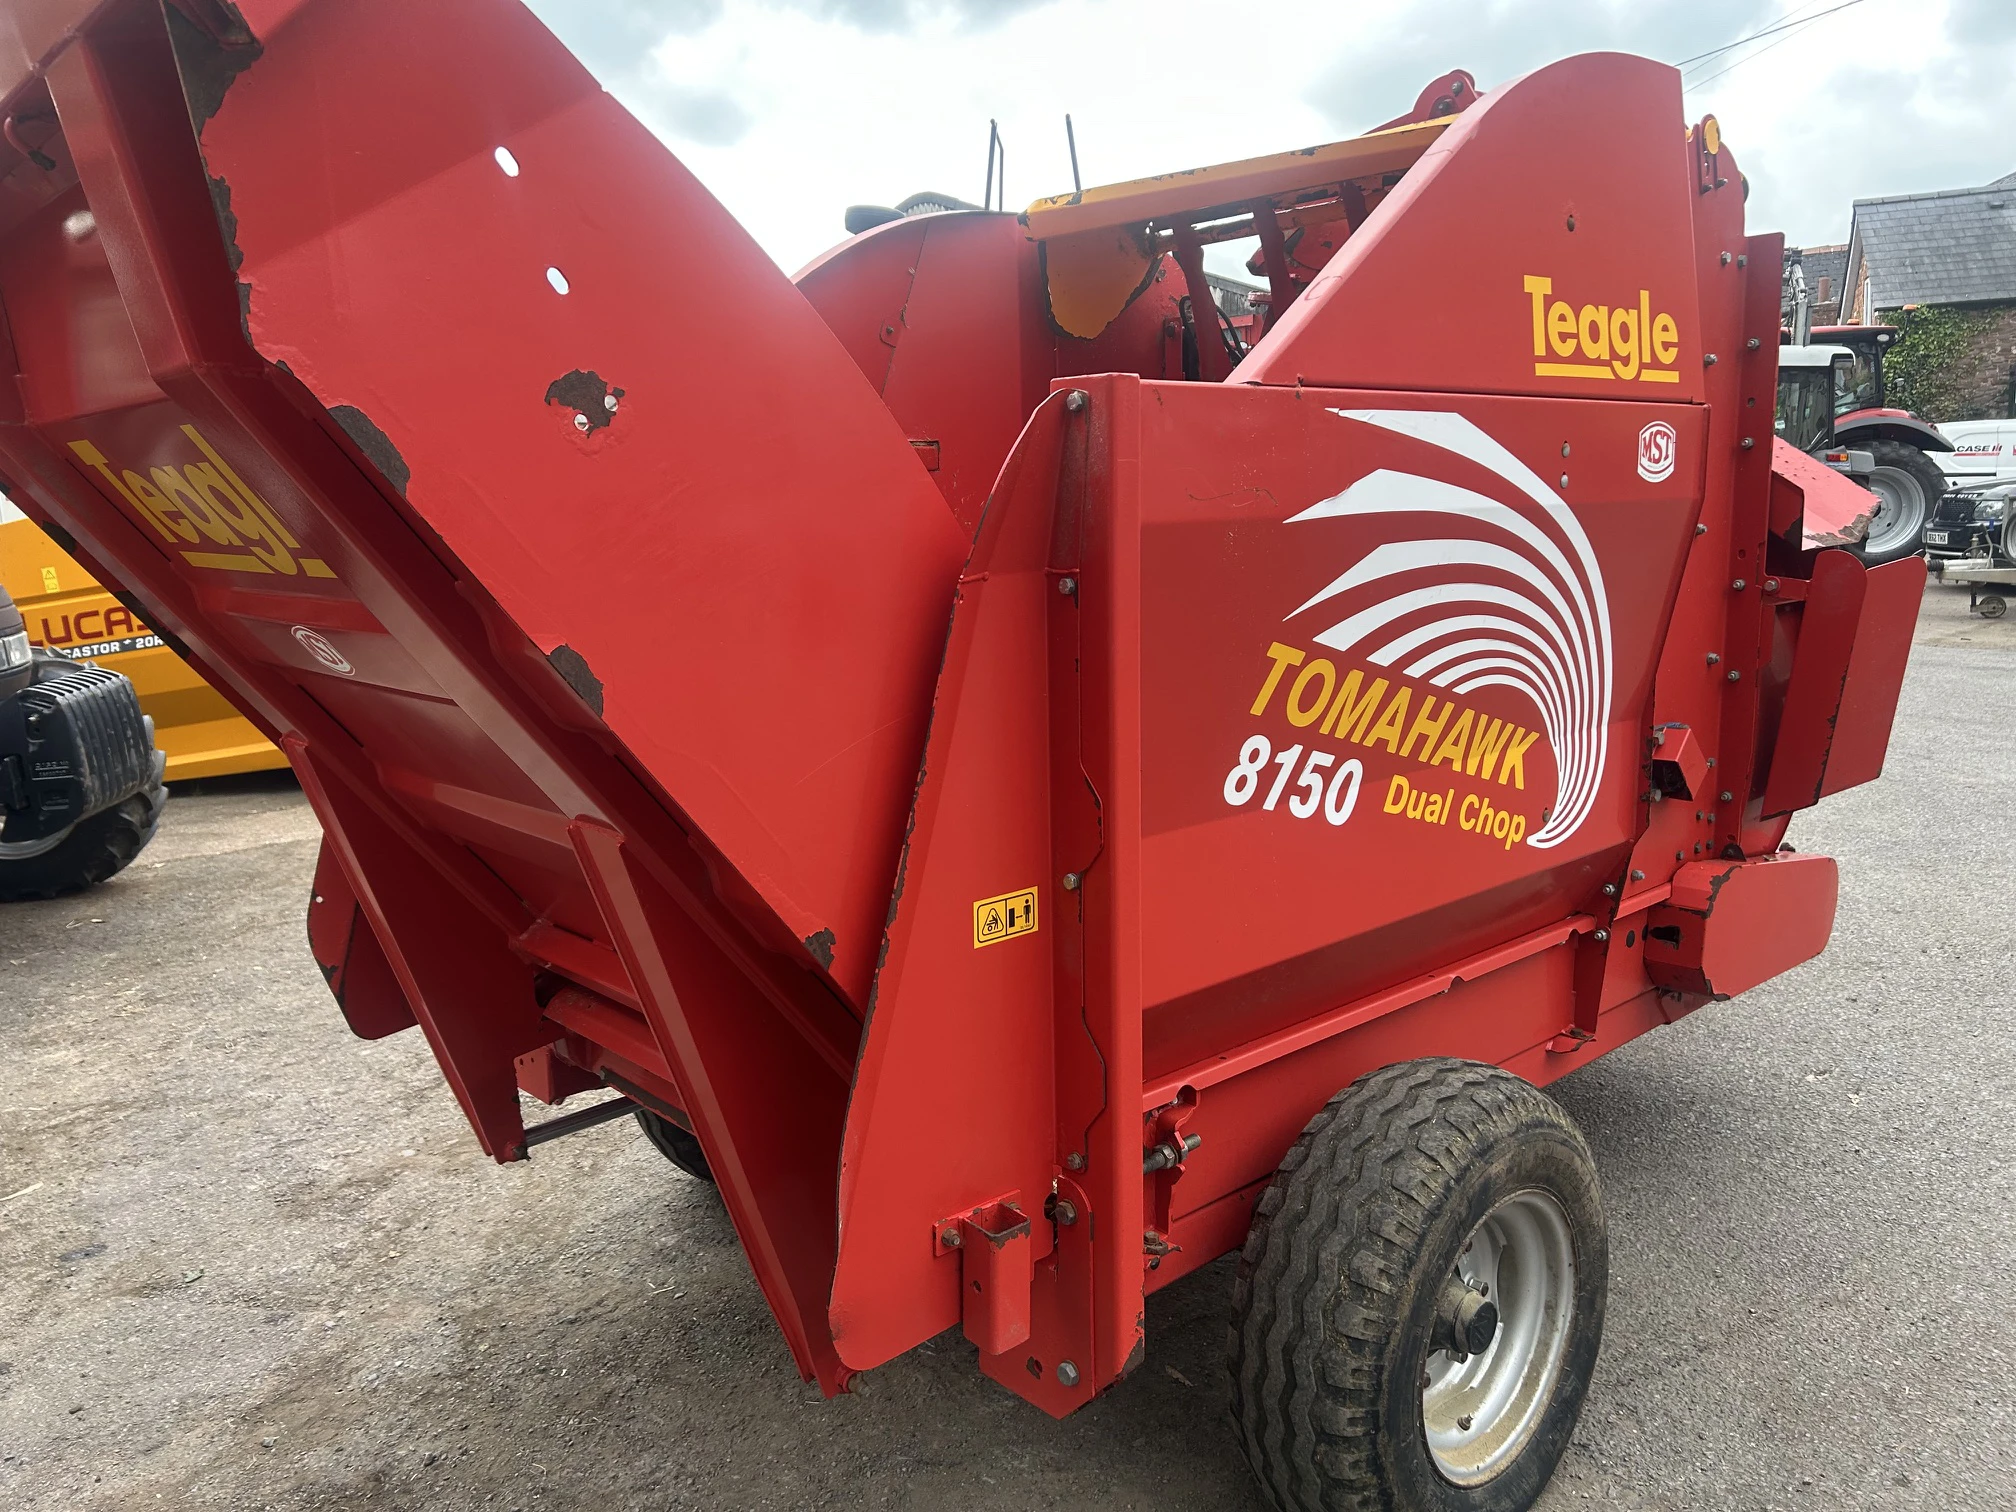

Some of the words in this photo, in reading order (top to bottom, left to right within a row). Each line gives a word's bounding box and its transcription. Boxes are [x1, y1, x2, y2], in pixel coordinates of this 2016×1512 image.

[1524, 274, 1679, 381] Teagle
[1641, 429, 1672, 465] MST
[67, 423, 301, 576] Teagl
[20, 606, 150, 646] LUCA
[1250, 641, 1540, 790] TOMAHAWK
[1223, 735, 1363, 826] 8150
[1383, 774, 1455, 826] Dual
[1459, 793, 1526, 850] Chop
